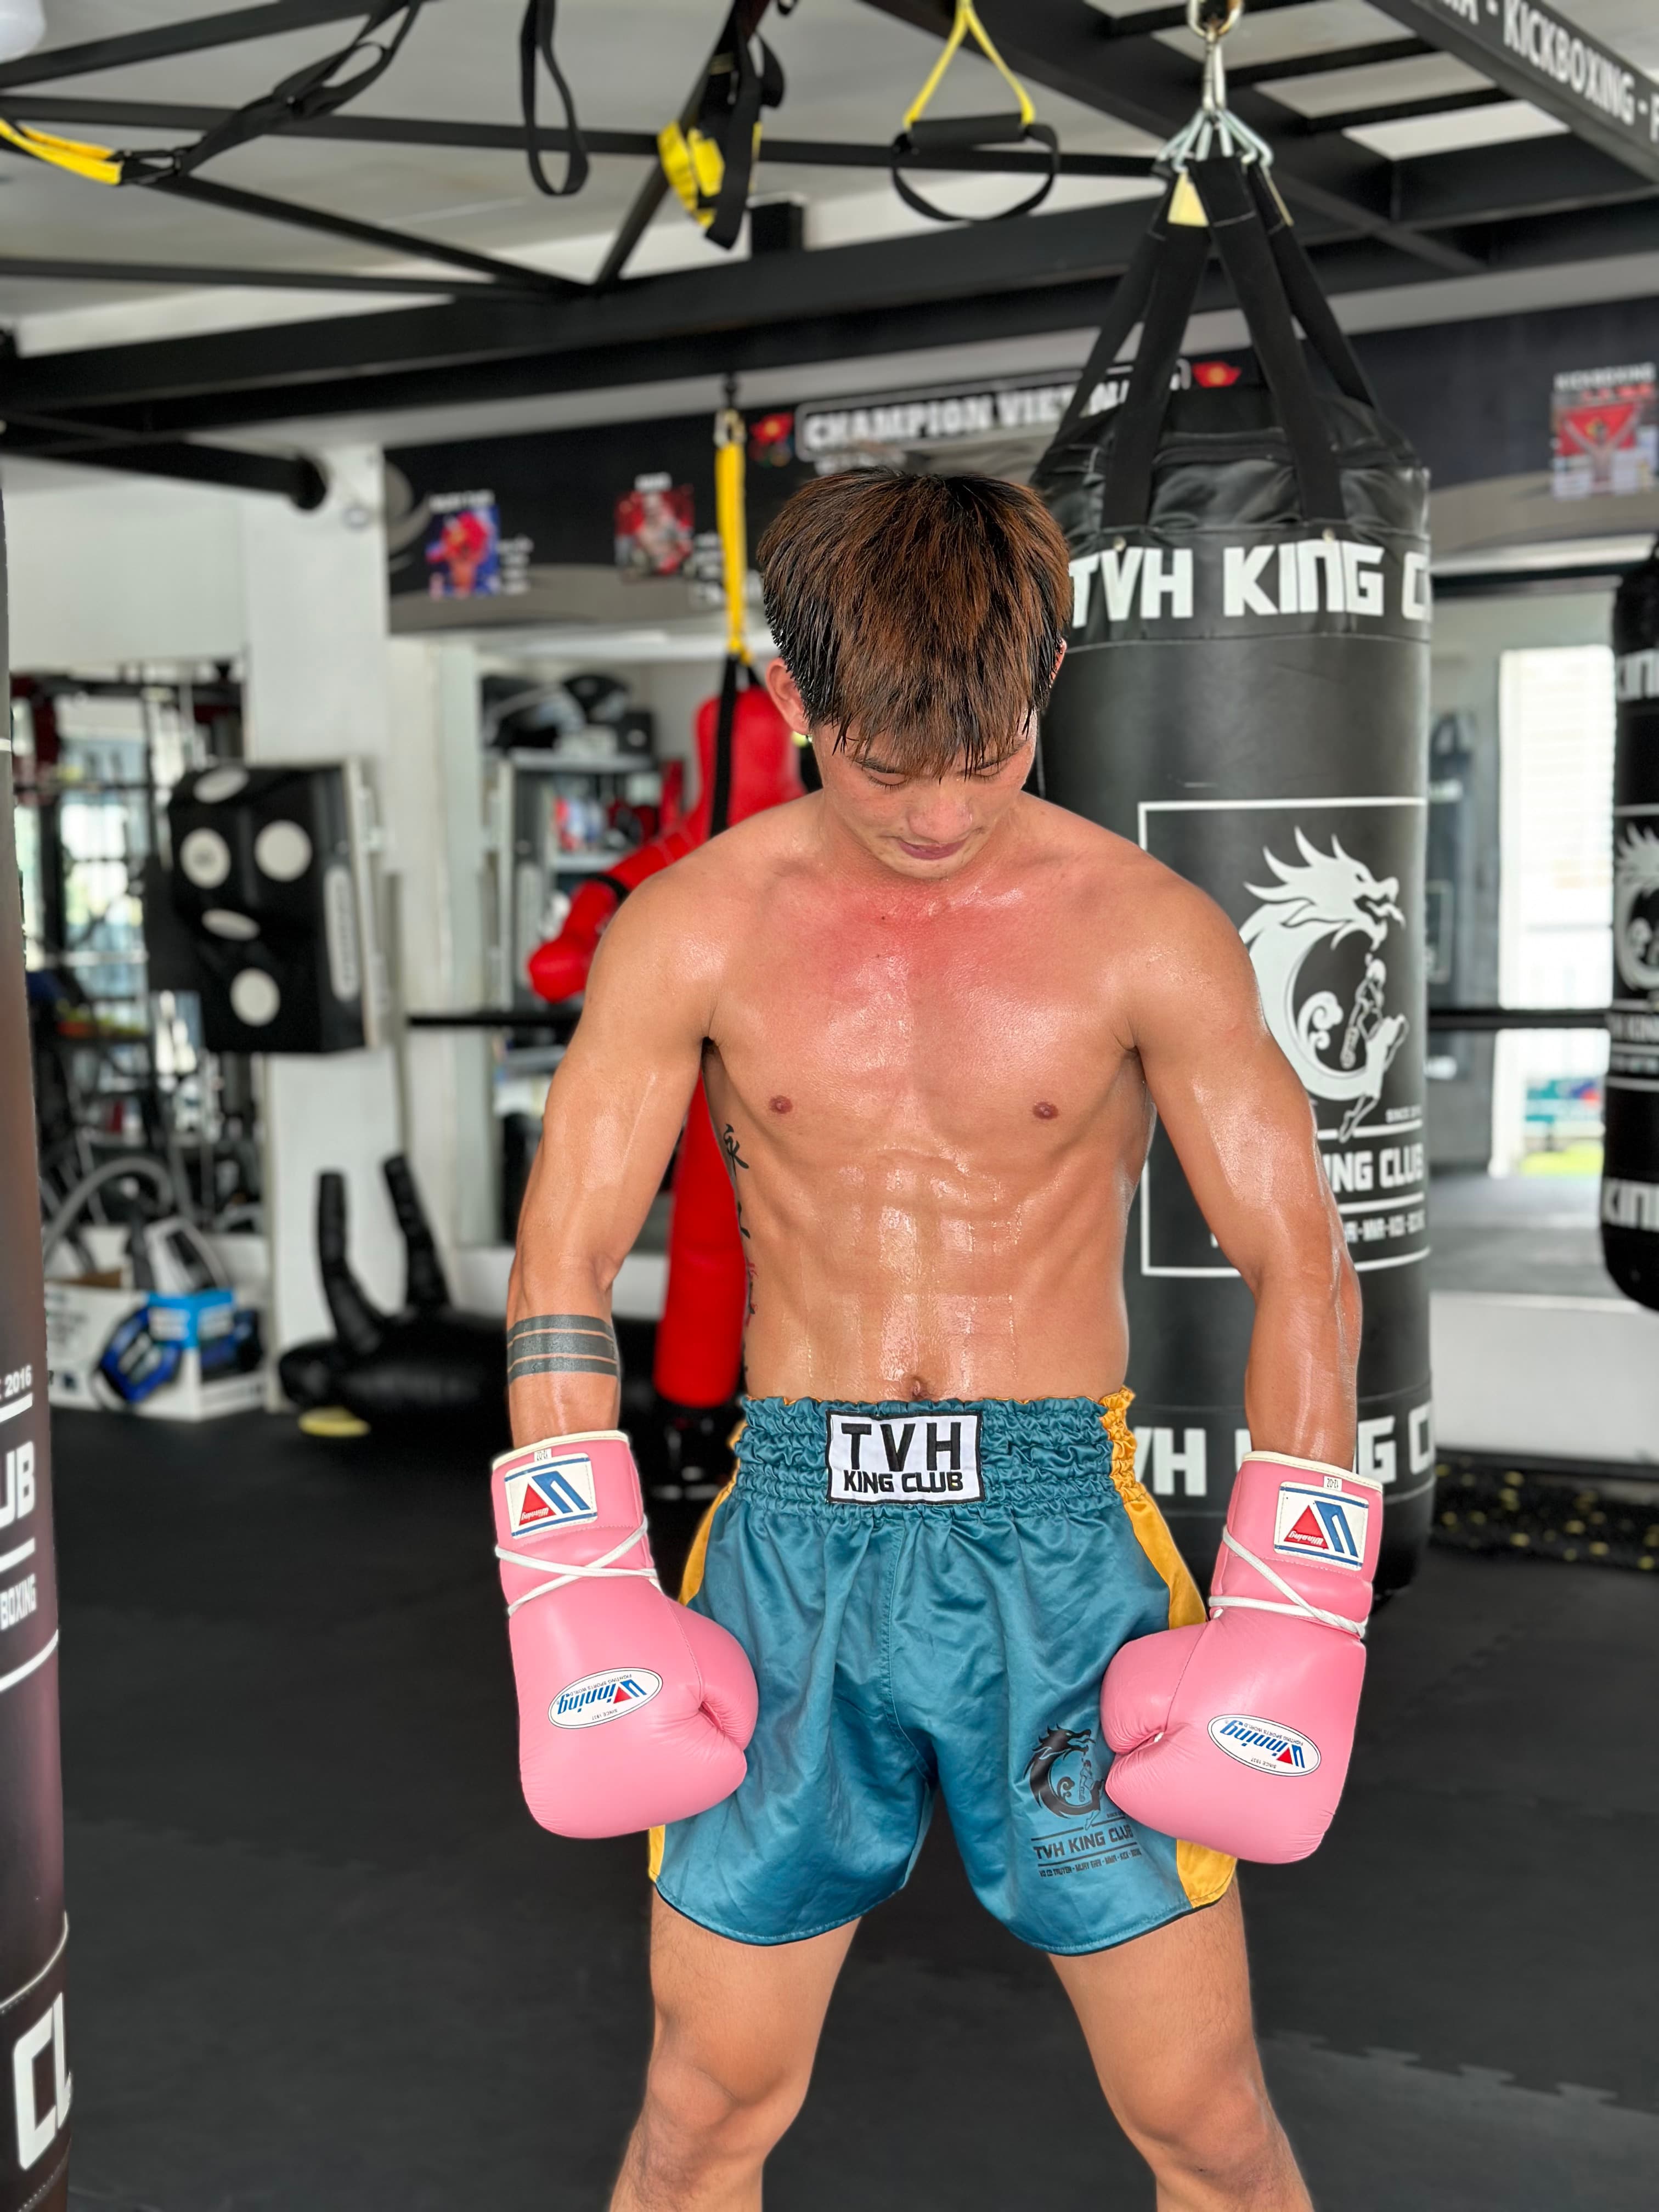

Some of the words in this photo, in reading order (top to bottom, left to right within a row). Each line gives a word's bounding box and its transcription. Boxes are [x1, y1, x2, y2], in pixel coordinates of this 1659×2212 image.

[1504, 0, 1635, 126] KICKBOXING
[803, 395, 993, 451] CHAMPION
[1224, 539, 1385, 616] KING
[1379, 1142, 1424, 1188] CLUB
[5, 1363, 32, 1398] 2016
[841, 1421, 962, 1472] TVH
[843, 1470, 894, 1494] KING
[901, 1471, 963, 1493] CLUB
[1288, 1530, 1325, 1546] Winning
[0, 1573, 37, 1631] BOXING
[588, 1680, 607, 1690] SPORTS
[607, 1673, 633, 1684] FIGHTING
[557, 1679, 647, 1715] Winning
[602, 1708, 618, 1718] SINCE
[1220, 1720, 1306, 1769] Winning
[1263, 1729, 1283, 1740] SPORTS
[1282, 1735, 1304, 1746] FIGHTING
[1262, 1760, 1277, 1769] SINCE
[1032, 1841, 1065, 1859] TVH
[1068, 1831, 1106, 1854] KING
[1108, 1825, 1133, 1842] CLUB
